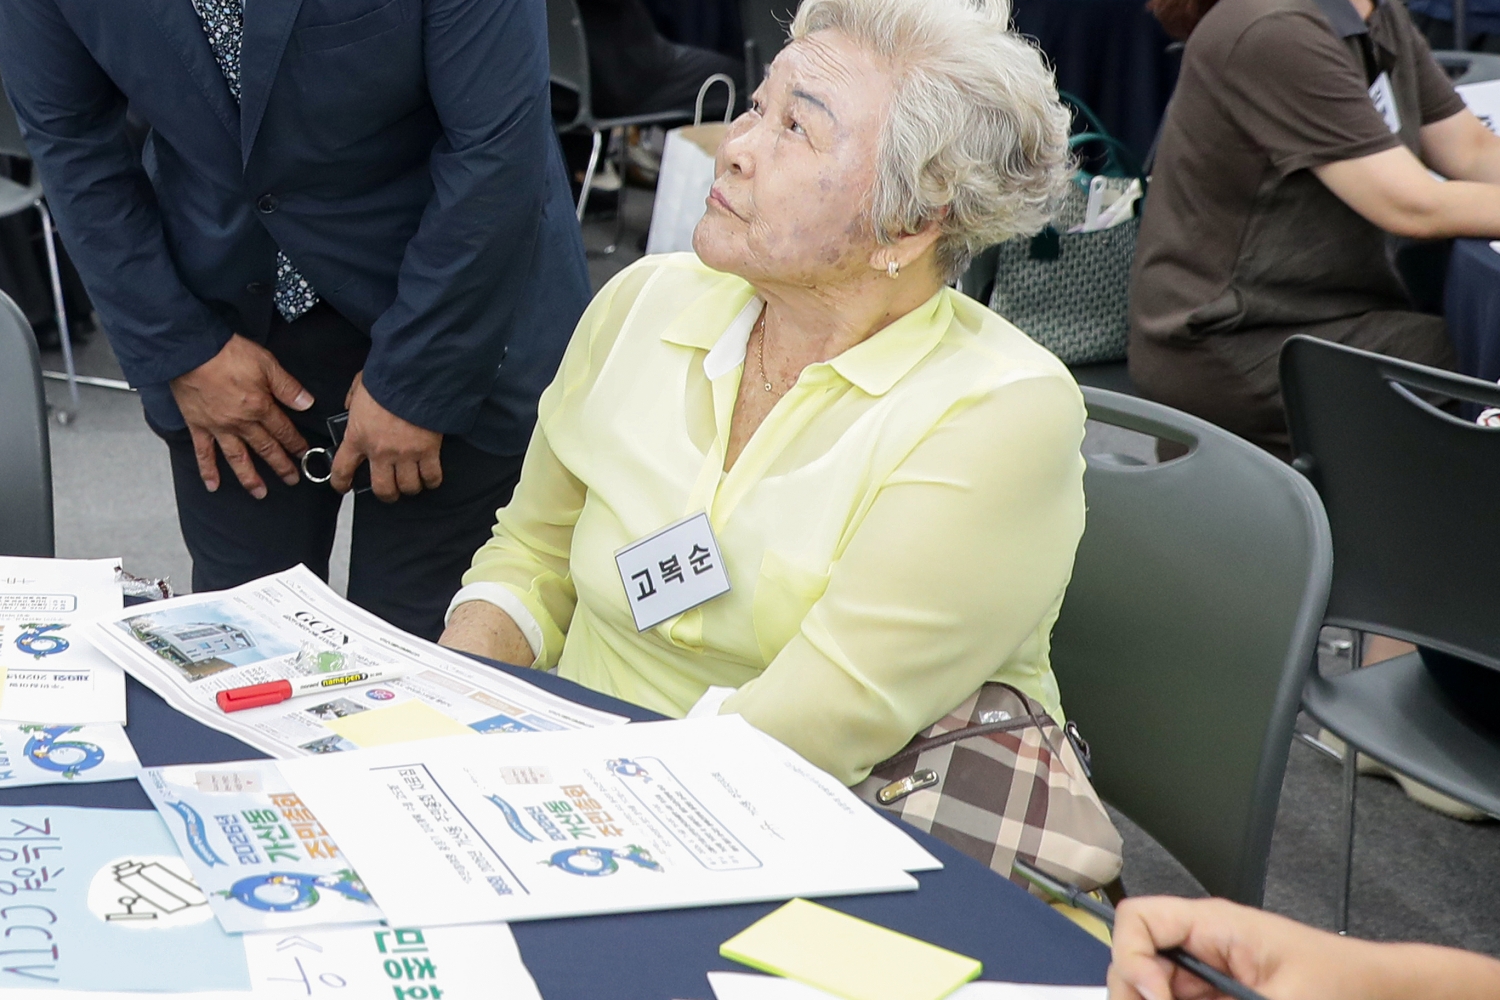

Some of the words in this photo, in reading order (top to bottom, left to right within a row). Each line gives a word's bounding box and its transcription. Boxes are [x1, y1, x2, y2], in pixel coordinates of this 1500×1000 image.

[631, 543, 713, 601] 고복순
[323, 673, 361, 687] namepen
[242, 809, 301, 863] 가산동
[268, 793, 340, 859] 주민총회
[543, 800, 596, 839] 가산동
[560, 785, 624, 837] 주민총회
[214, 814, 262, 864] 2026년
